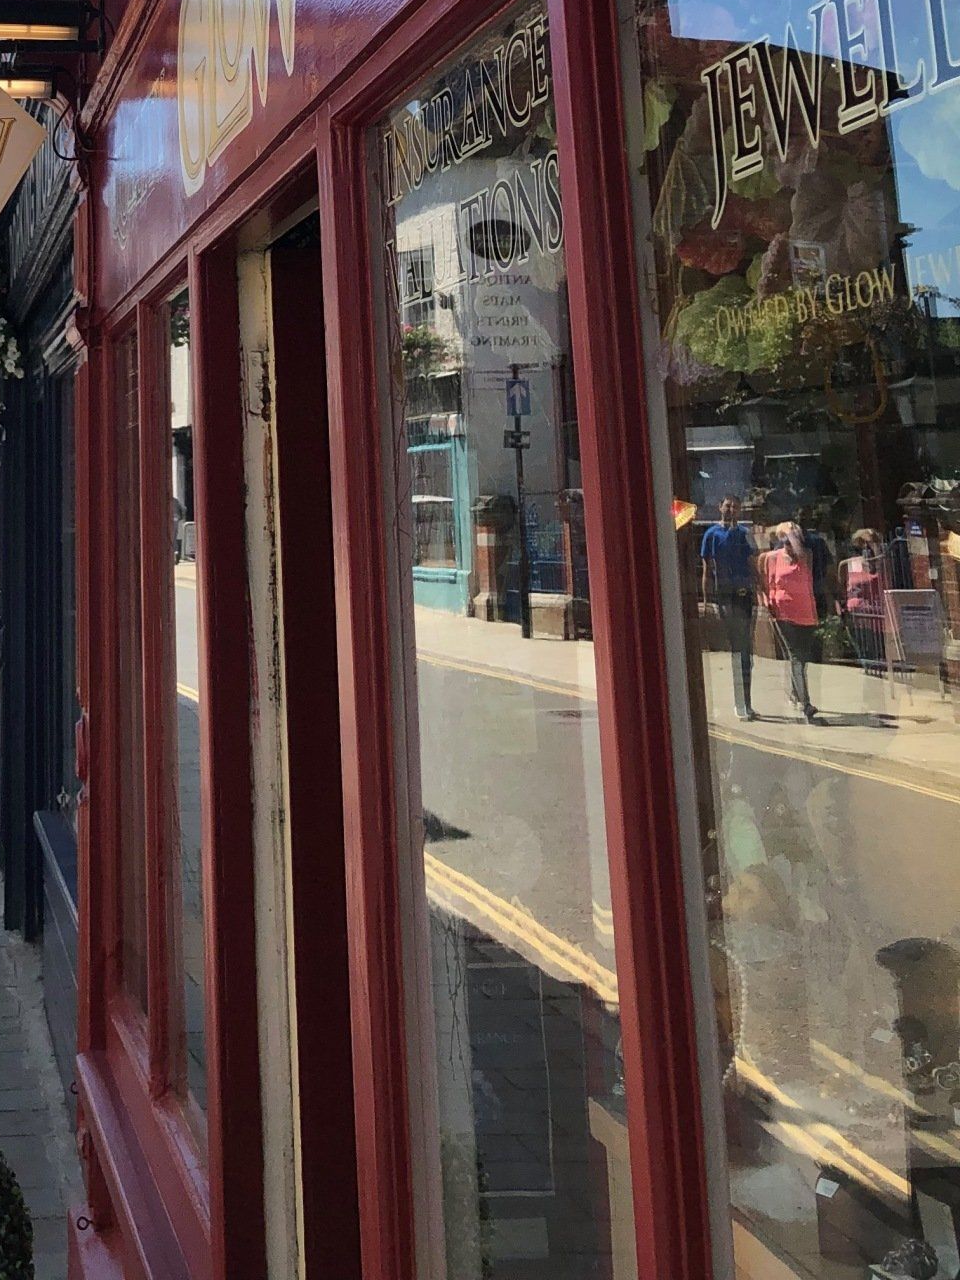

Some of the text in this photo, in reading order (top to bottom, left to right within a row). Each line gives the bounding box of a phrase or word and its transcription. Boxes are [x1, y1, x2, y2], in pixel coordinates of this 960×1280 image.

[383, 14, 550, 208] INSURANCE
[385, 149, 565, 311] VALUATIONS
[795, 285, 819, 324] BY
[825, 263, 897, 315] GLOW
